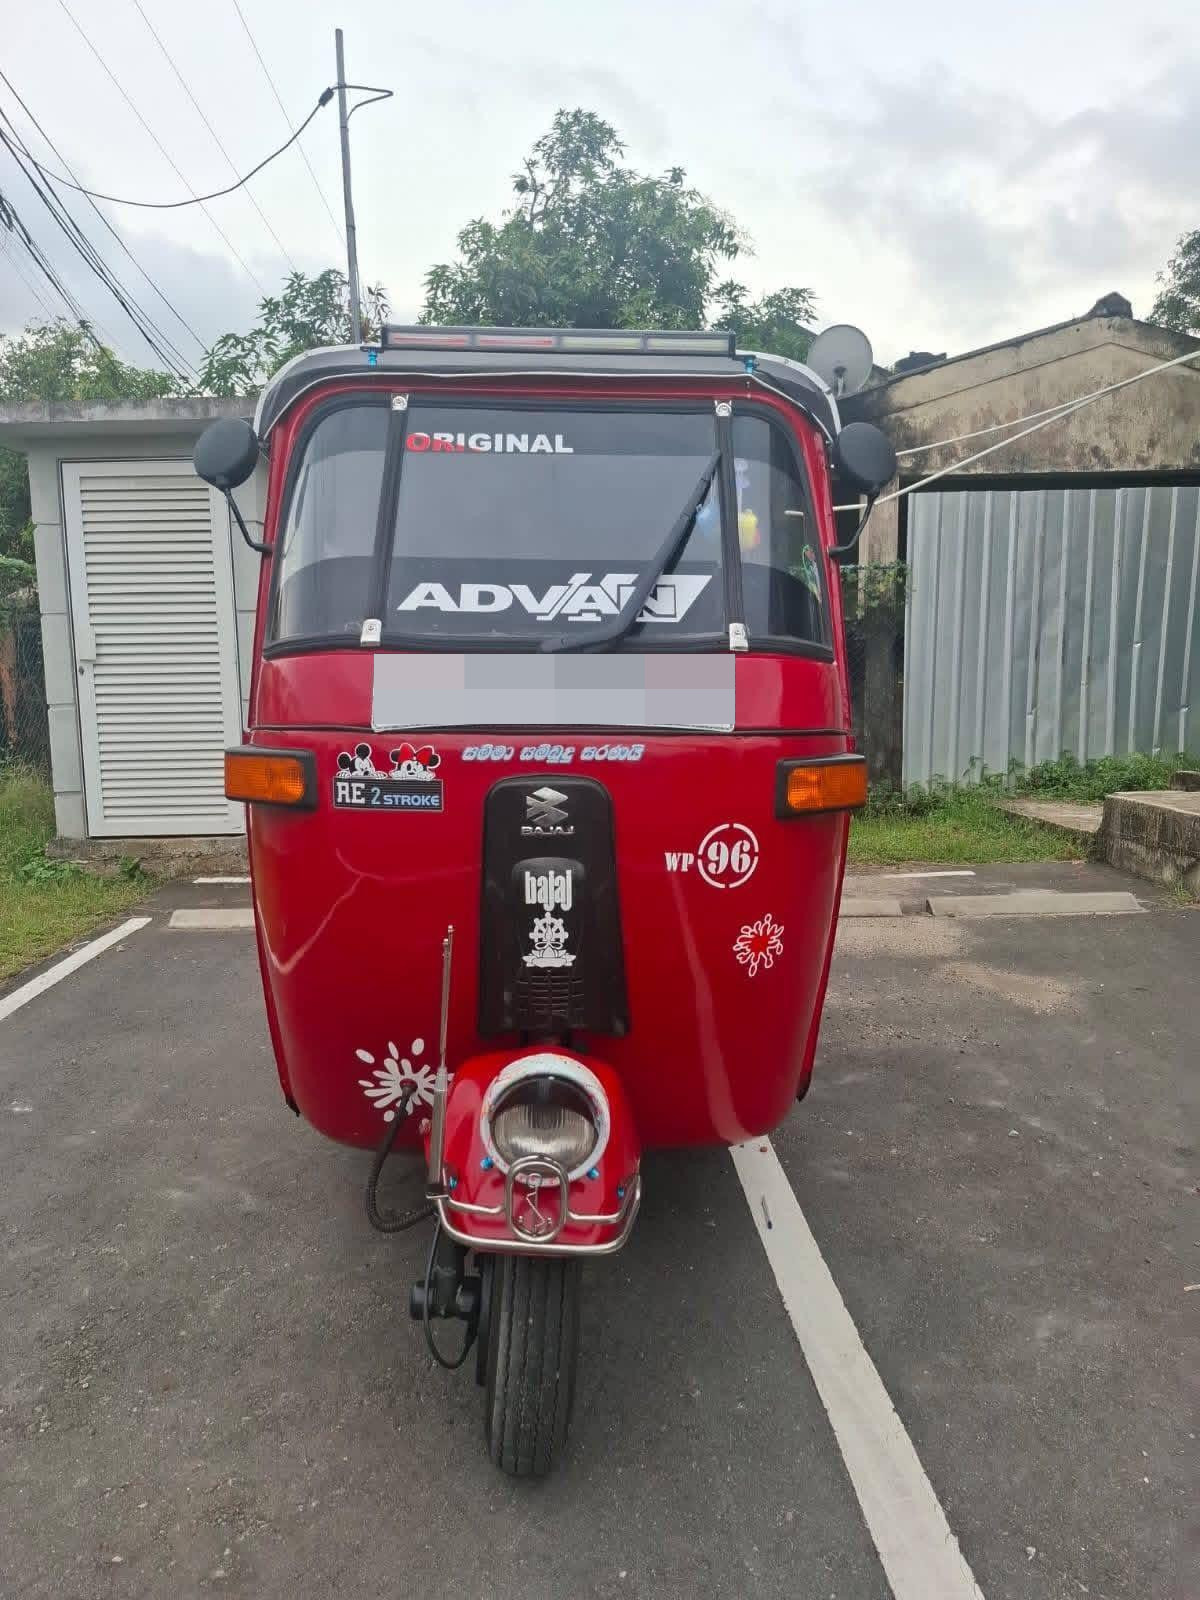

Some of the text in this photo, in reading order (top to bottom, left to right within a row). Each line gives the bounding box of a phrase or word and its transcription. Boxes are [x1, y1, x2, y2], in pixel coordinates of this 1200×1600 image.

[406, 432, 574, 454] ORIGINAL
[371, 787, 381, 804] 2
[383, 794, 440, 806] STROKE
[520, 825, 575, 836] BAJAJ
[664, 840, 751, 875] WP 96
[524, 870, 572, 912] bajaj
